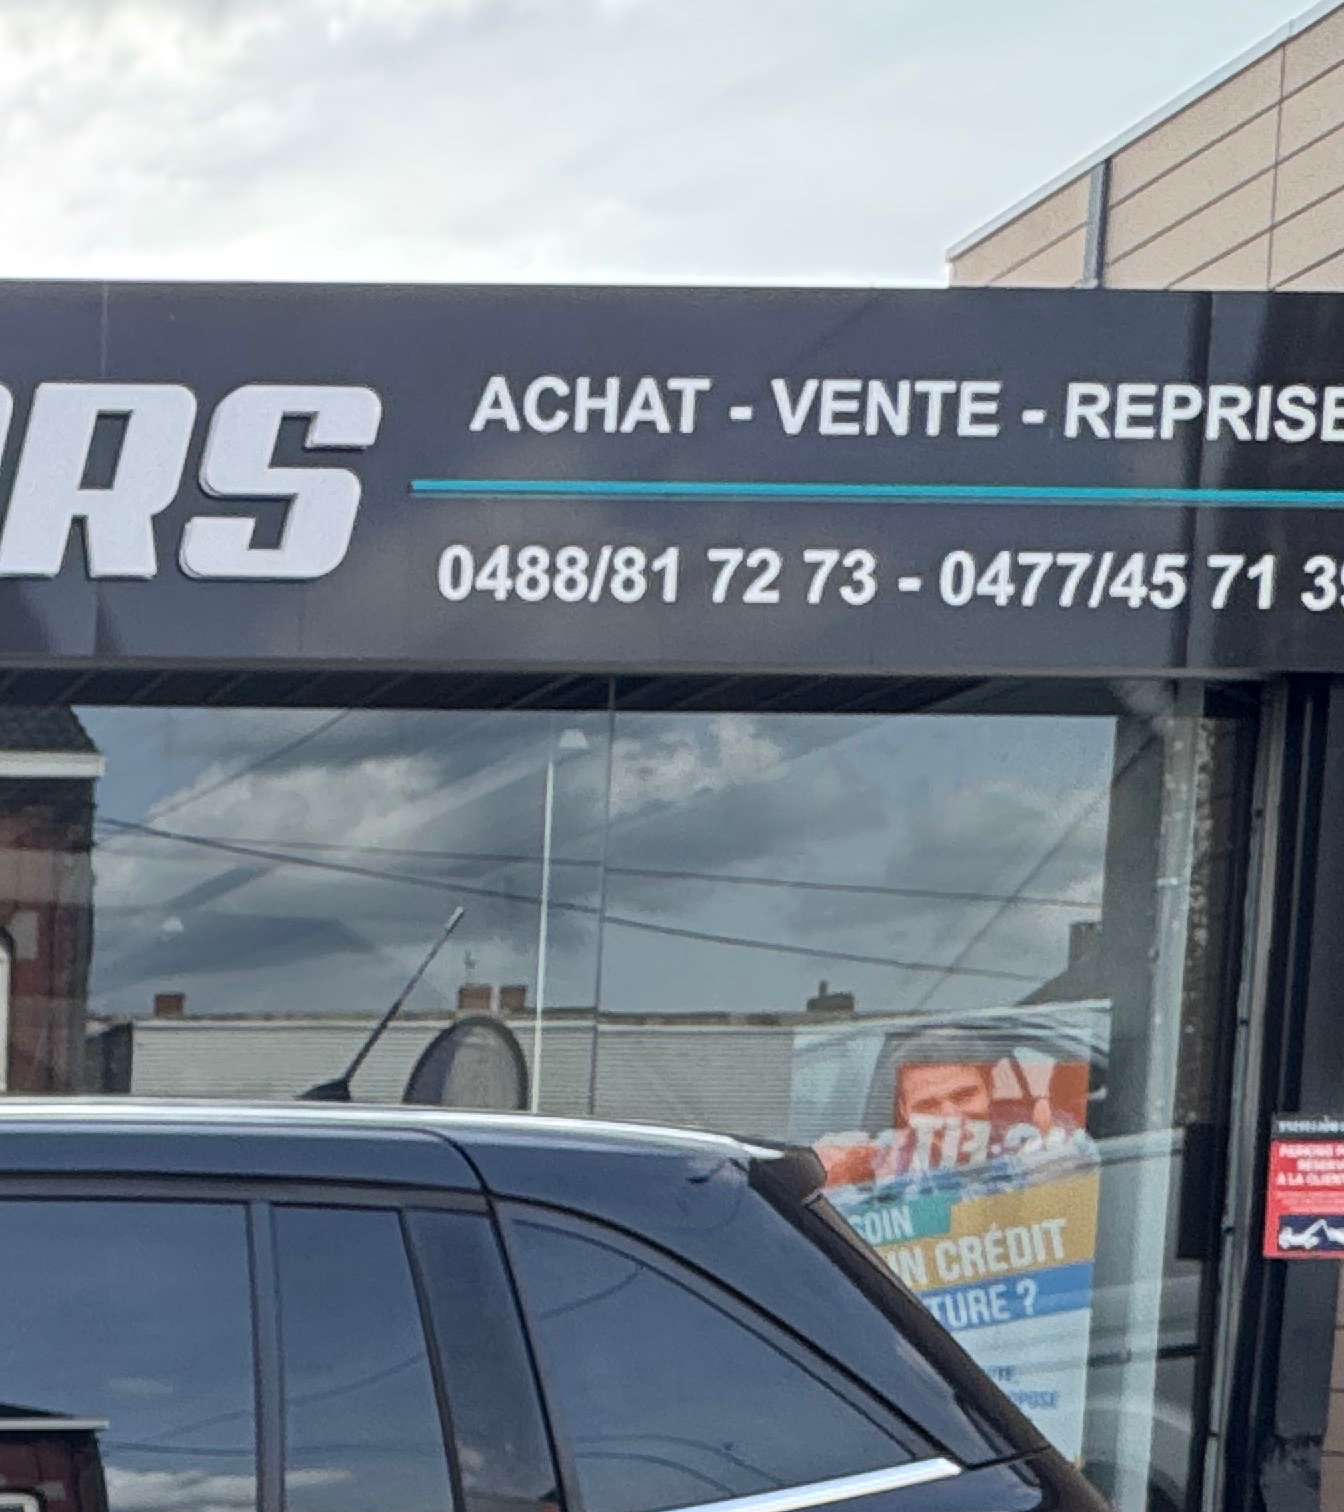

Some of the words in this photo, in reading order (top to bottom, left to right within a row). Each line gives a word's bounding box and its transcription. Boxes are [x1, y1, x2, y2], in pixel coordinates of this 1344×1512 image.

[469, 374, 712, 435] ACHAT
[728, 402, 754, 421] -
[771, 377, 1004, 437] VENTE
[1022, 408, 1047, 425] -
[1063, 382, 1344, 443] REPRISE
[438, 545, 680, 605] 0488/81
[708, 547, 782, 604] 72
[803, 548, 877, 605] 73
[939, 550, 1188, 609] 0477/45
[1206, 553, 1276, 610] 71
[1300, 554, 1344, 612] 3
[935, 1219, 1068, 1281] CRÉDIT
[1016, 1278, 1038, 1315] ?
